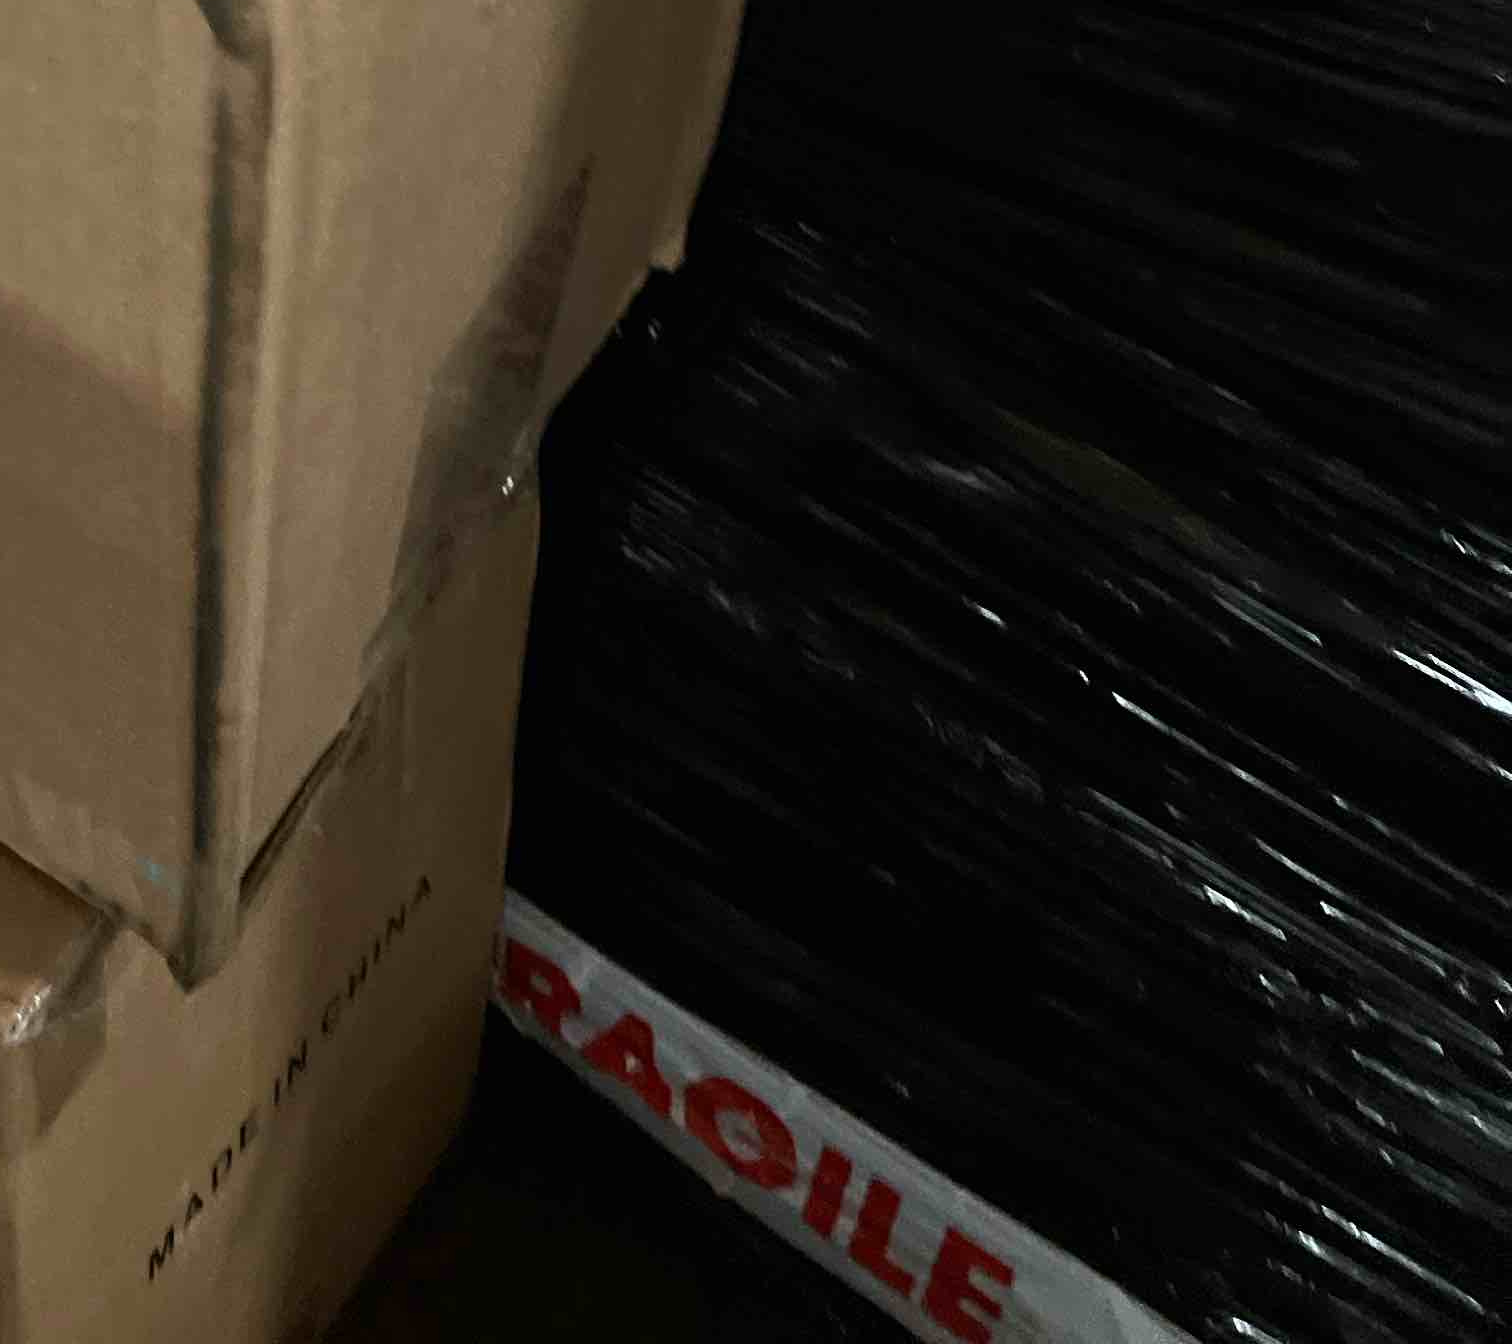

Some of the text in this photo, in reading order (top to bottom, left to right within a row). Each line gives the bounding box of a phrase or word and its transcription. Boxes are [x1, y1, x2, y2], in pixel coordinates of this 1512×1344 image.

[147, 875, 433, 1281] MADE IN CHINA
[494, 936, 1018, 1344] RAGILE
